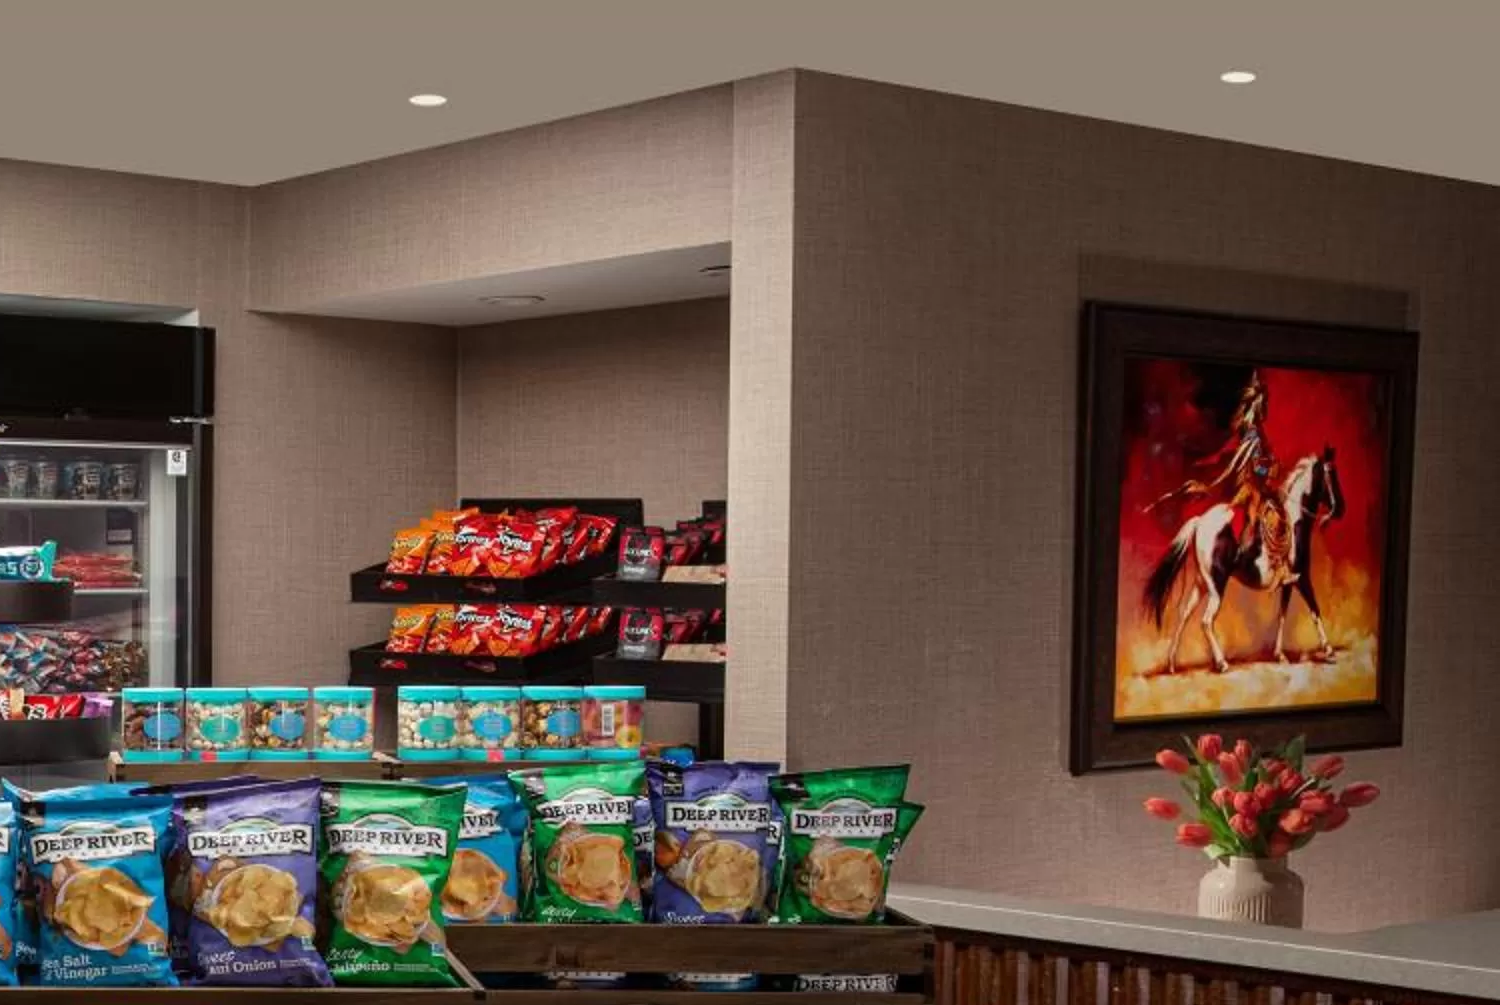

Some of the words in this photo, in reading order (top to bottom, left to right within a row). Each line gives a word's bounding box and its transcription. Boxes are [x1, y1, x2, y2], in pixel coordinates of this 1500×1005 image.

[543, 802, 583, 819] DEEP
[672, 807, 717, 822] DEEP
[720, 807, 769, 822] RIVER
[796, 814, 840, 829] DEEP
[843, 813, 896, 828] RIVER
[34, 836, 84, 857] DEEP
[88, 830, 149, 849] RIVER
[192, 833, 243, 851] DEEP
[245, 828, 309, 846] RIVER
[329, 829, 376, 847] DEEP
[379, 830, 444, 849] RIVER
[63, 954, 92, 967] Salt
[233, 960, 277, 973] Onion
[51, 967, 108, 980] Vinegar
